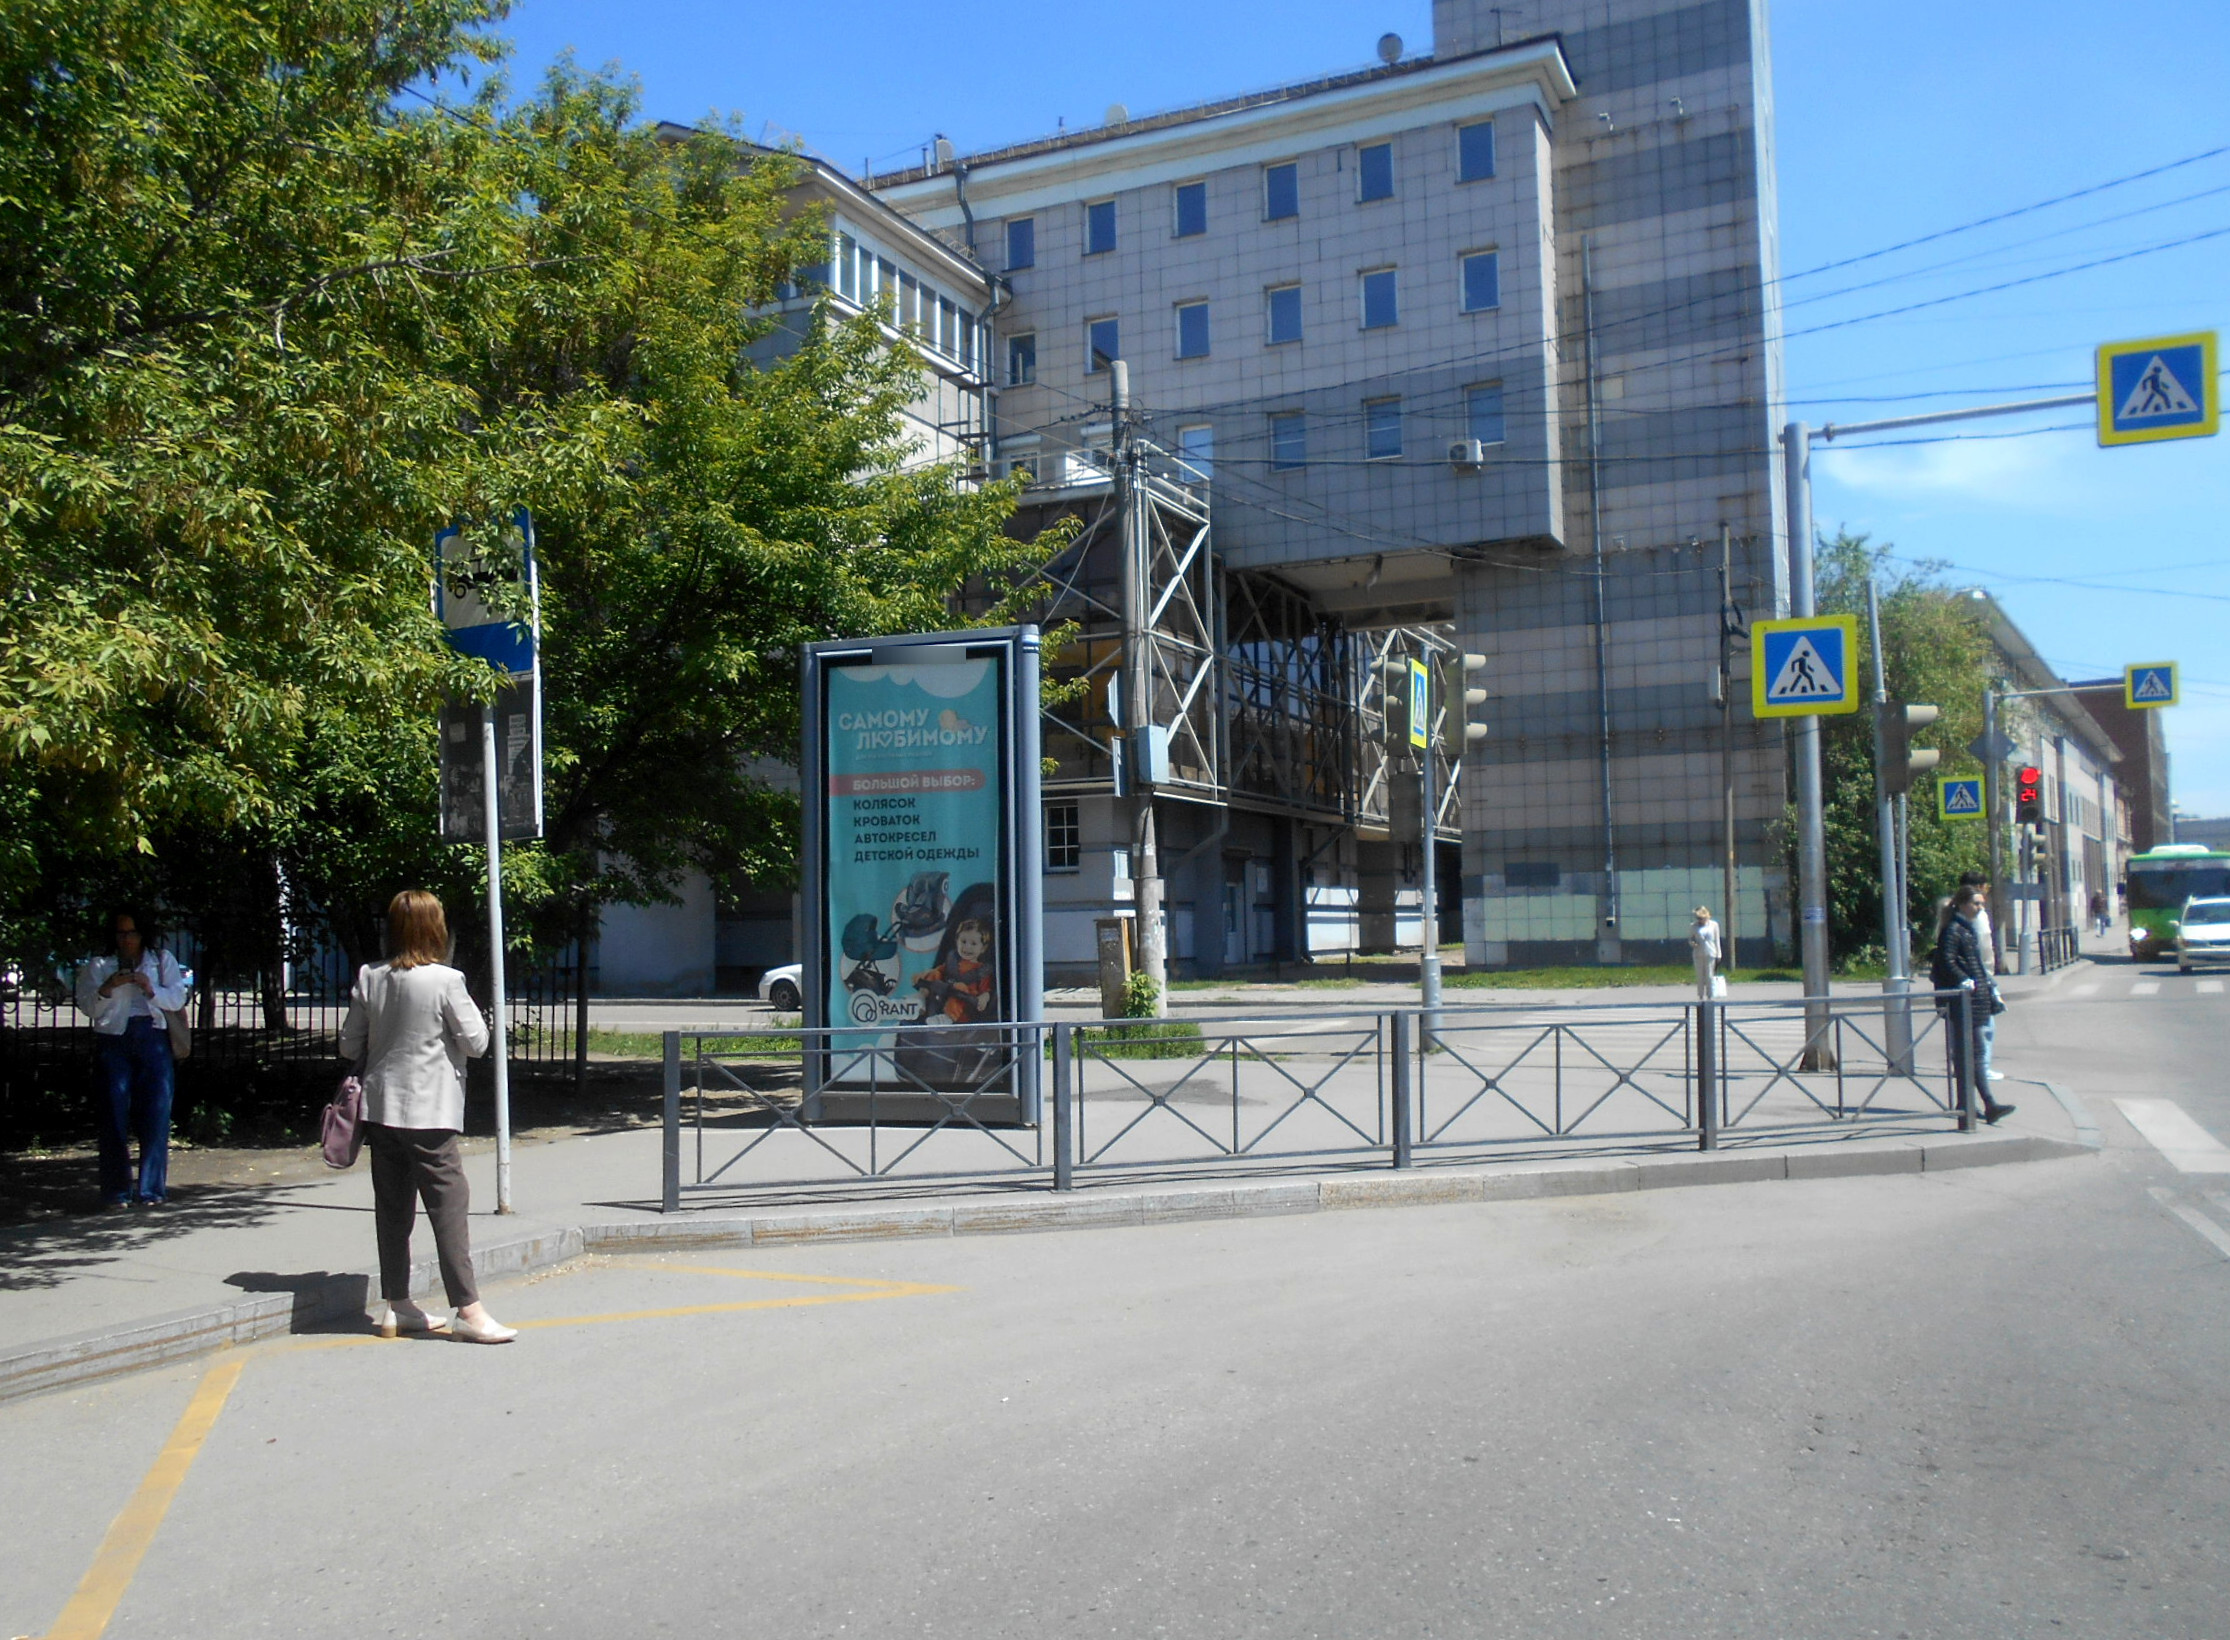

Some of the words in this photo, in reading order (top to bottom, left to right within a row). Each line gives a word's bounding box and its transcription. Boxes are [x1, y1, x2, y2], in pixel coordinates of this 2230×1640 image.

[838, 708, 929, 731] САМОМУ
[856, 725, 989, 750] ЛЮБИМОМУ
[853, 774, 920, 791] БОЛЬШОЙ
[922, 775, 976, 788] ВЫБОР:
[853, 798, 916, 811] КОЛЯСОК
[853, 814, 920, 828] КРОВАТОК
[854, 831, 937, 844] АВТОКРЕСЕЛ
[854, 847, 914, 863] ДЕТСКОЙ
[916, 848, 980, 861] ОДЕЖДЫ
